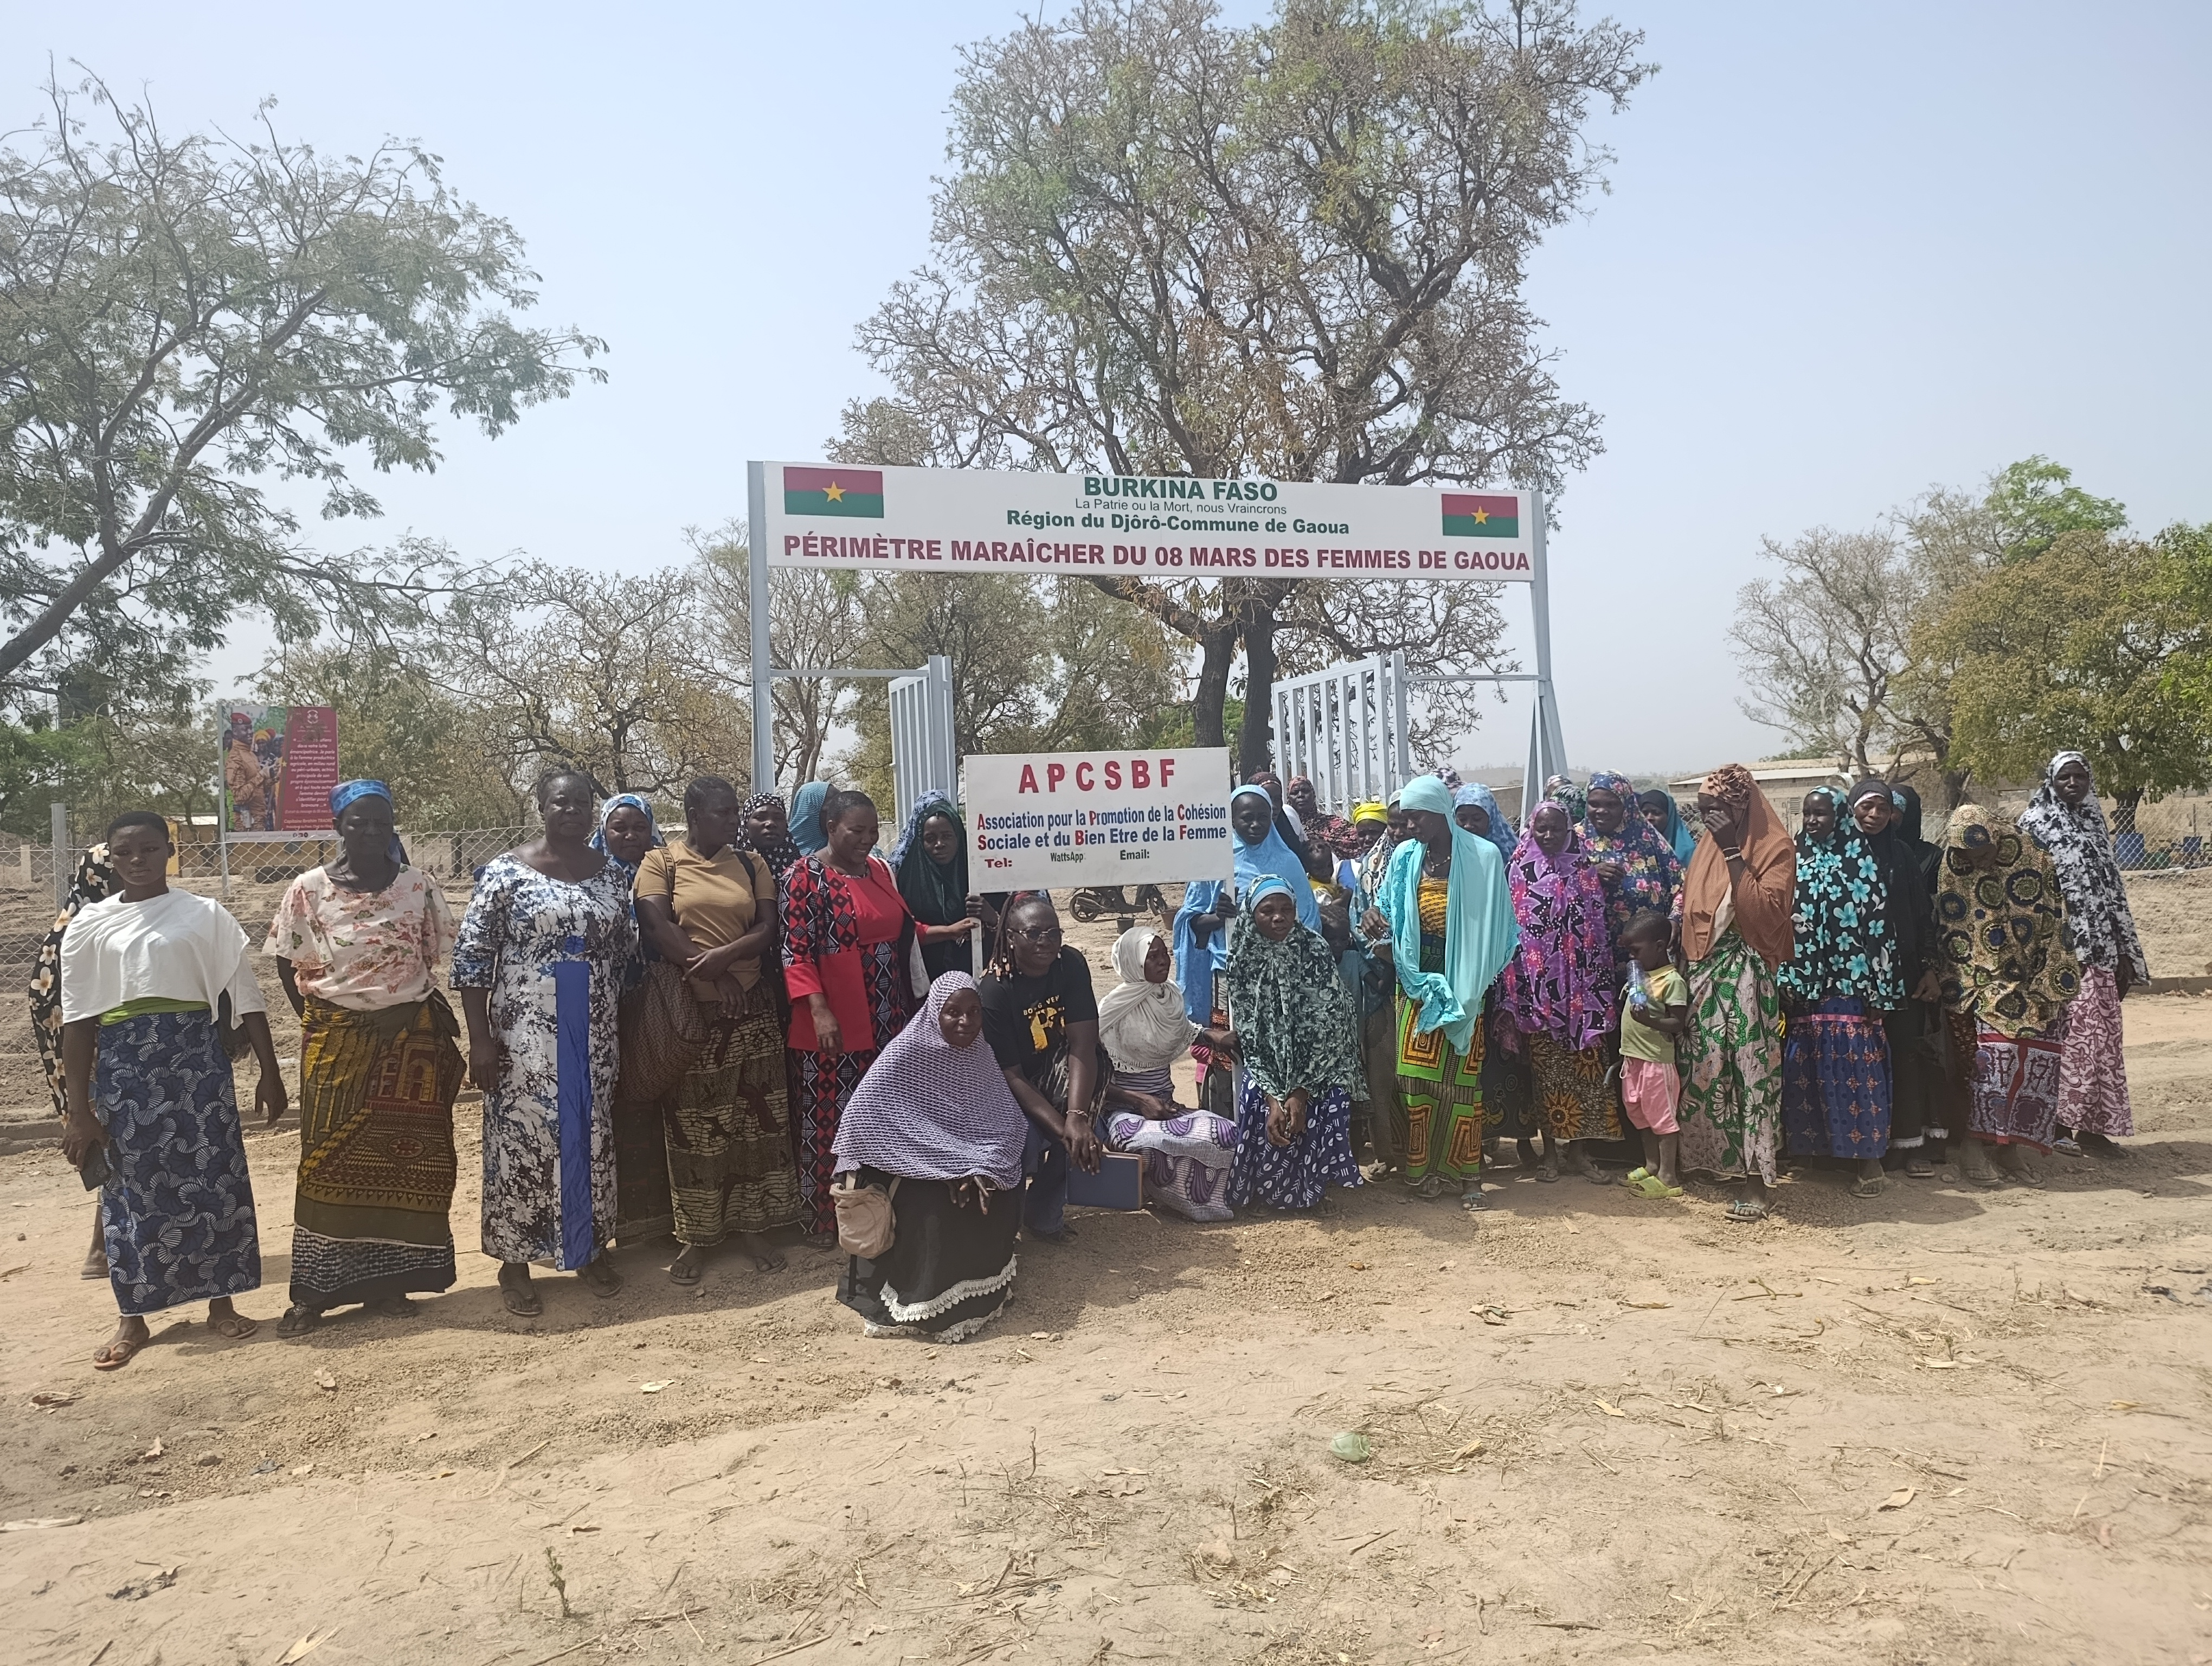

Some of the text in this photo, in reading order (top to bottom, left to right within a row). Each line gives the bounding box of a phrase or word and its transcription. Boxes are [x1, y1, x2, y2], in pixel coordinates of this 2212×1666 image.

[1084, 477, 1277, 502] BURKINA FASO
[1076, 498, 1287, 515] La Patrie ou la Mort, nous Vraincrons
[1007, 510, 1349, 534] Région du Djôrô-Commune de Gaoua
[784, 531, 1530, 570] PÉRIMÈTRE MARAÎCHER DU 08 MARS DES FEMMES DE GAOUA
[977, 803, 1226, 831] Association pour la Promotion de la Cohésion
[978, 825, 1227, 850] Sociale et du Bien Etre de la Femme
[985, 857, 1012, 868] Tel:
[1120, 849, 1150, 860] Email:
